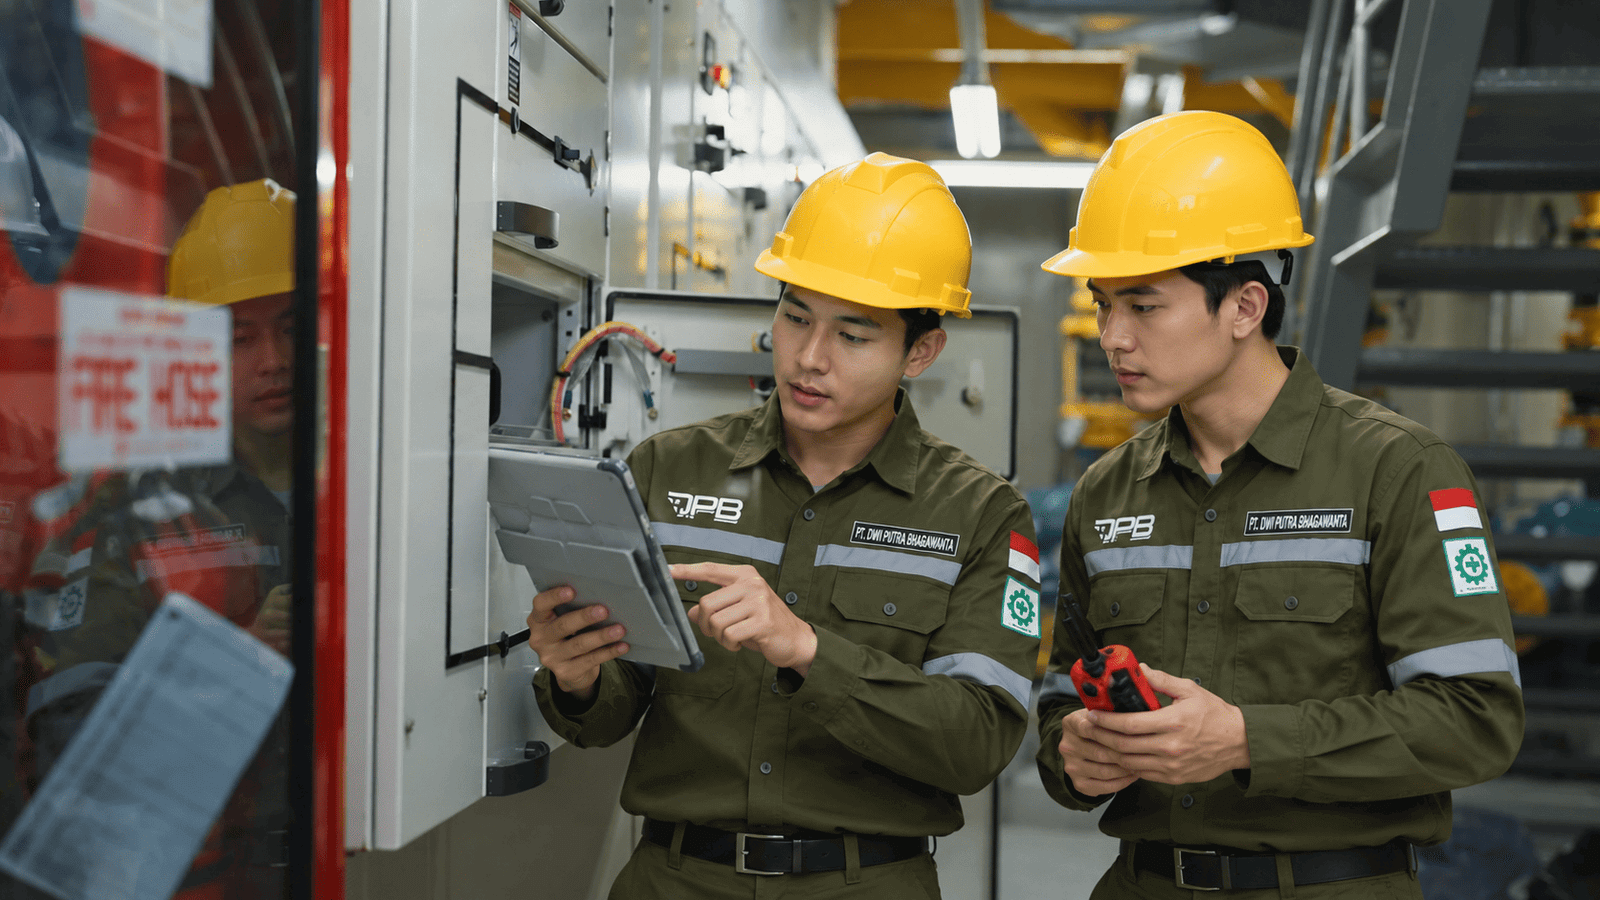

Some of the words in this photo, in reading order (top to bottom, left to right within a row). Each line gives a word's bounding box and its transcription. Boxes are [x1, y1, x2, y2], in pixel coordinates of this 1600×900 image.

[1275, 515, 1297, 530] PUTRA
[854, 527, 865, 540] PT.
[866, 528, 884, 542] DWI
[882, 530, 906, 545] PUTRA
[906, 532, 954, 552] BHAGAWANTA
